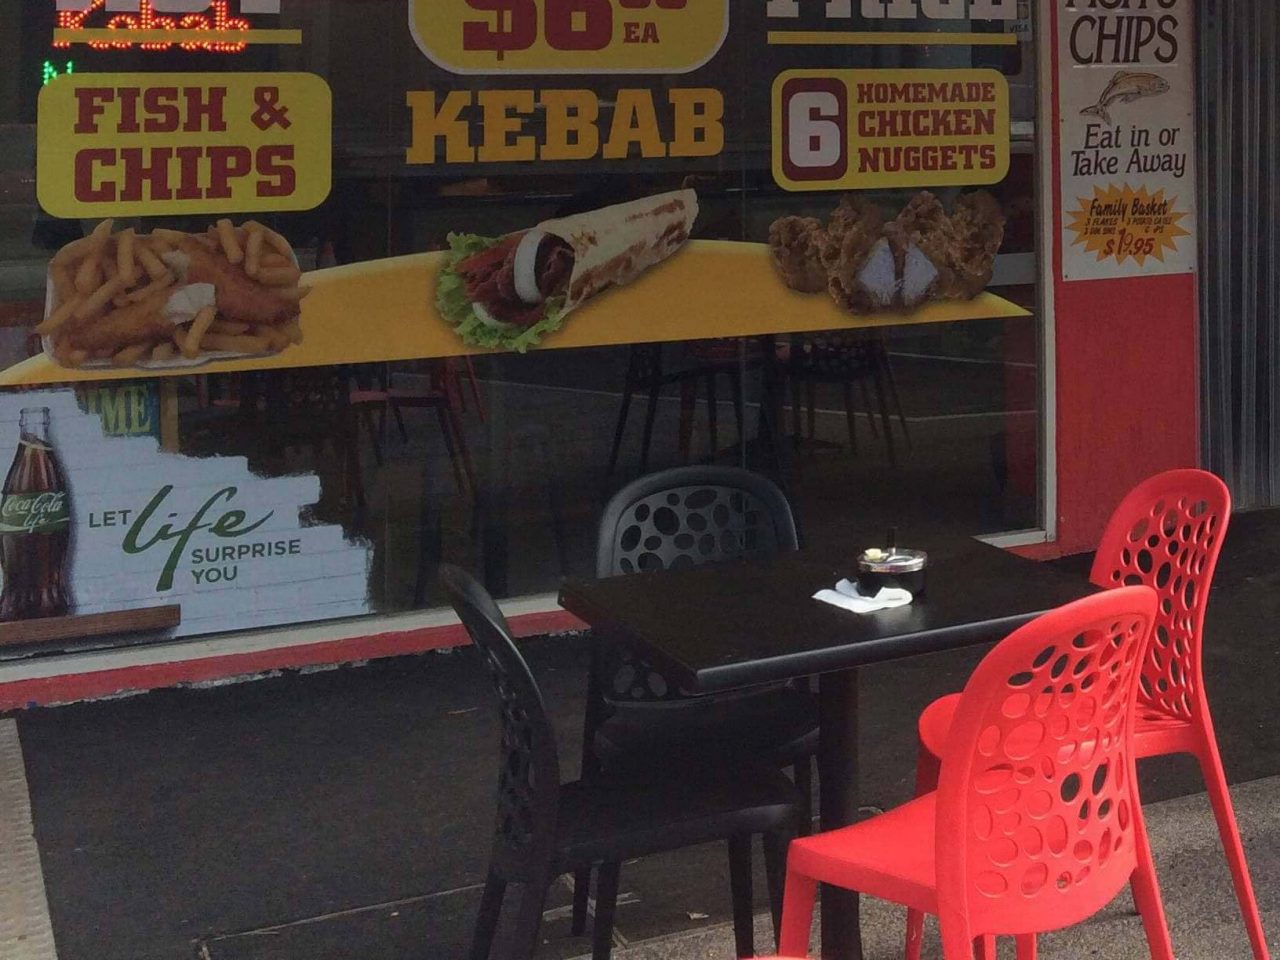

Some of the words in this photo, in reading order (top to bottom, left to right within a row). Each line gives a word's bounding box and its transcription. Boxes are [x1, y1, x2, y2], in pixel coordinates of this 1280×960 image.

[623, 22, 660, 43] EA
[1069, 15, 1179, 64] CHIPS
[74, 86, 227, 133] FISH
[252, 86, 292, 131] &
[858, 109, 996, 137] CHICKEN
[406, 88, 724, 164] KEBAB
[789, 91, 840, 167] 6
[857, 82, 995, 103] HOMEMADE
[1084, 123, 1122, 149] Eat
[1131, 125, 1149, 147] in
[1159, 127, 1180, 146] or
[74, 144, 296, 202] CHIPS
[858, 145, 996, 173] NUGGETS
[1071, 150, 1118, 176] Take
[1126, 149, 1187, 178] Away
[1090, 198, 1128, 221] Family
[1131, 197, 1168, 216] Basket
[89, 509, 131, 528] LET
[122, 485, 274, 592] life
[191, 539, 301, 564] SURPRISE
[191, 567, 238, 585] YOU
